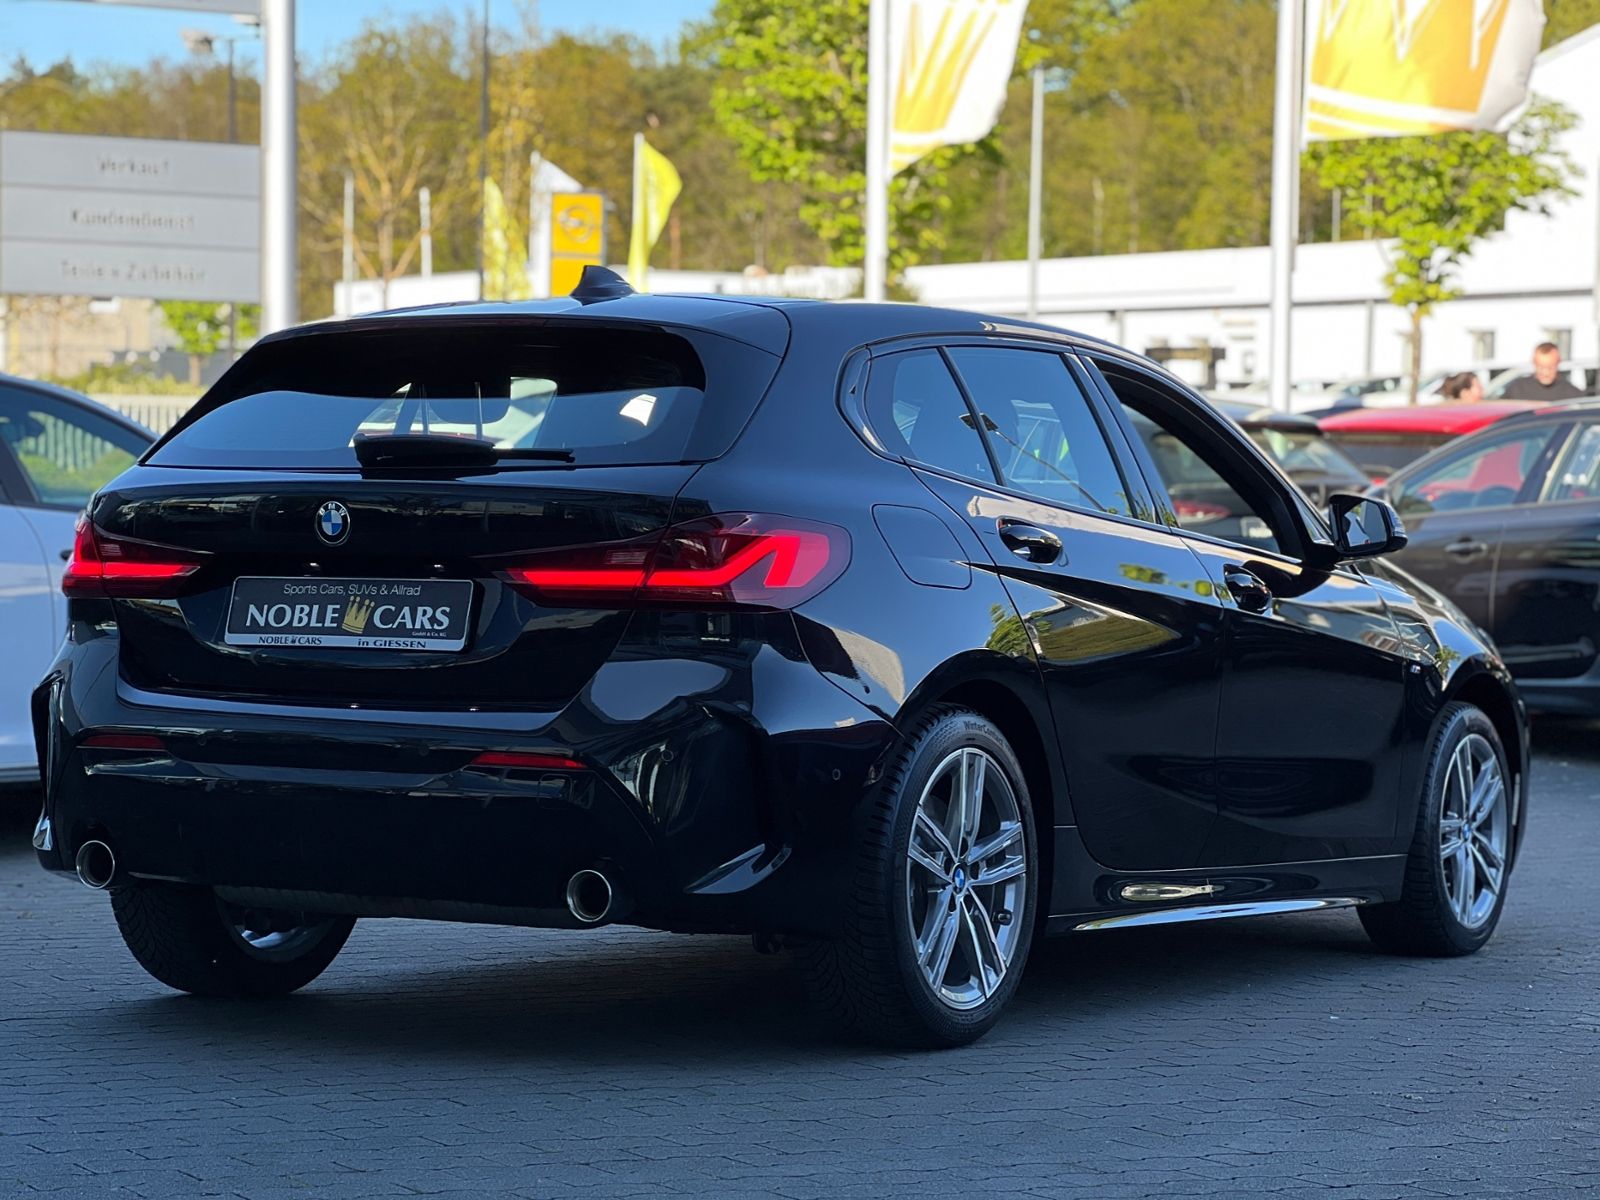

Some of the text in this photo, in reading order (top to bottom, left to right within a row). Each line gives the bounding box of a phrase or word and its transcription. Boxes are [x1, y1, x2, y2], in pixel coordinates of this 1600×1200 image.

[319, 502, 347, 517] BMW
[283, 583, 421, 596] Sports Cars, SUVs & Allrad
[245, 603, 451, 630] NOBLE CARS
[258, 636, 323, 646] NOBLE CARS
[357, 638, 427, 649] in GIESSEN
